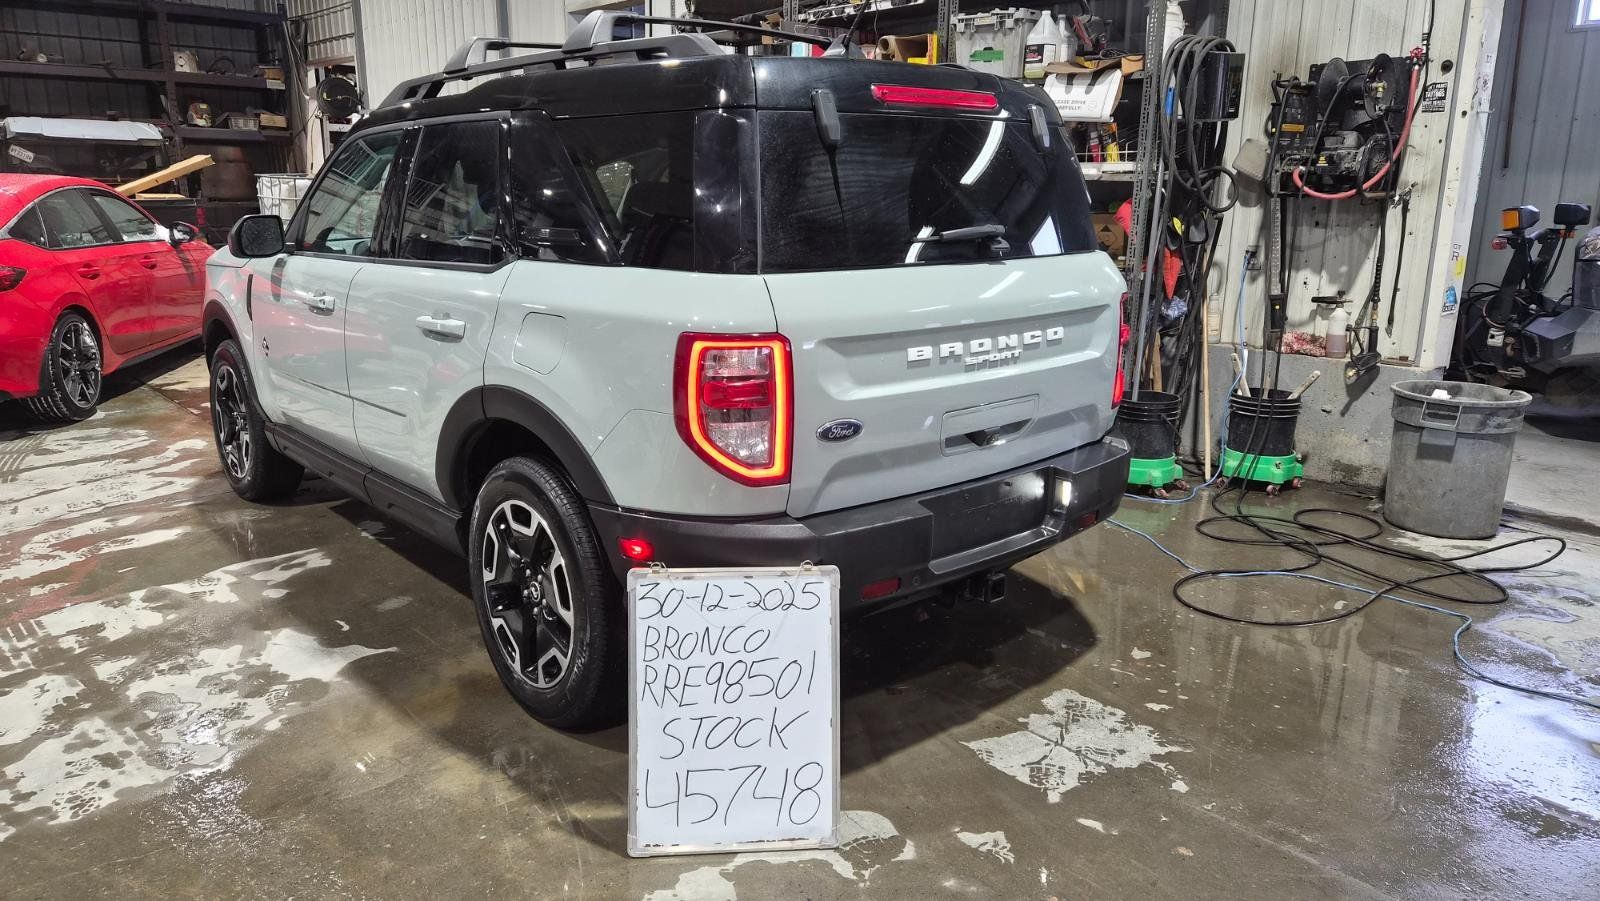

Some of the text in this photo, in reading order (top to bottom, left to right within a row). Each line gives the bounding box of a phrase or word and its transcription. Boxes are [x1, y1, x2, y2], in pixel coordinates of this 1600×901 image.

[907, 327, 1064, 361] BRONCO
[965, 349, 1023, 365] SPORT
[638, 580, 825, 619] 30-12-2025
[643, 625, 770, 662] BRONCO
[641, 650, 816, 708] RRE98501
[660, 707, 810, 759] STOCK
[645, 762, 824, 827] 45748
